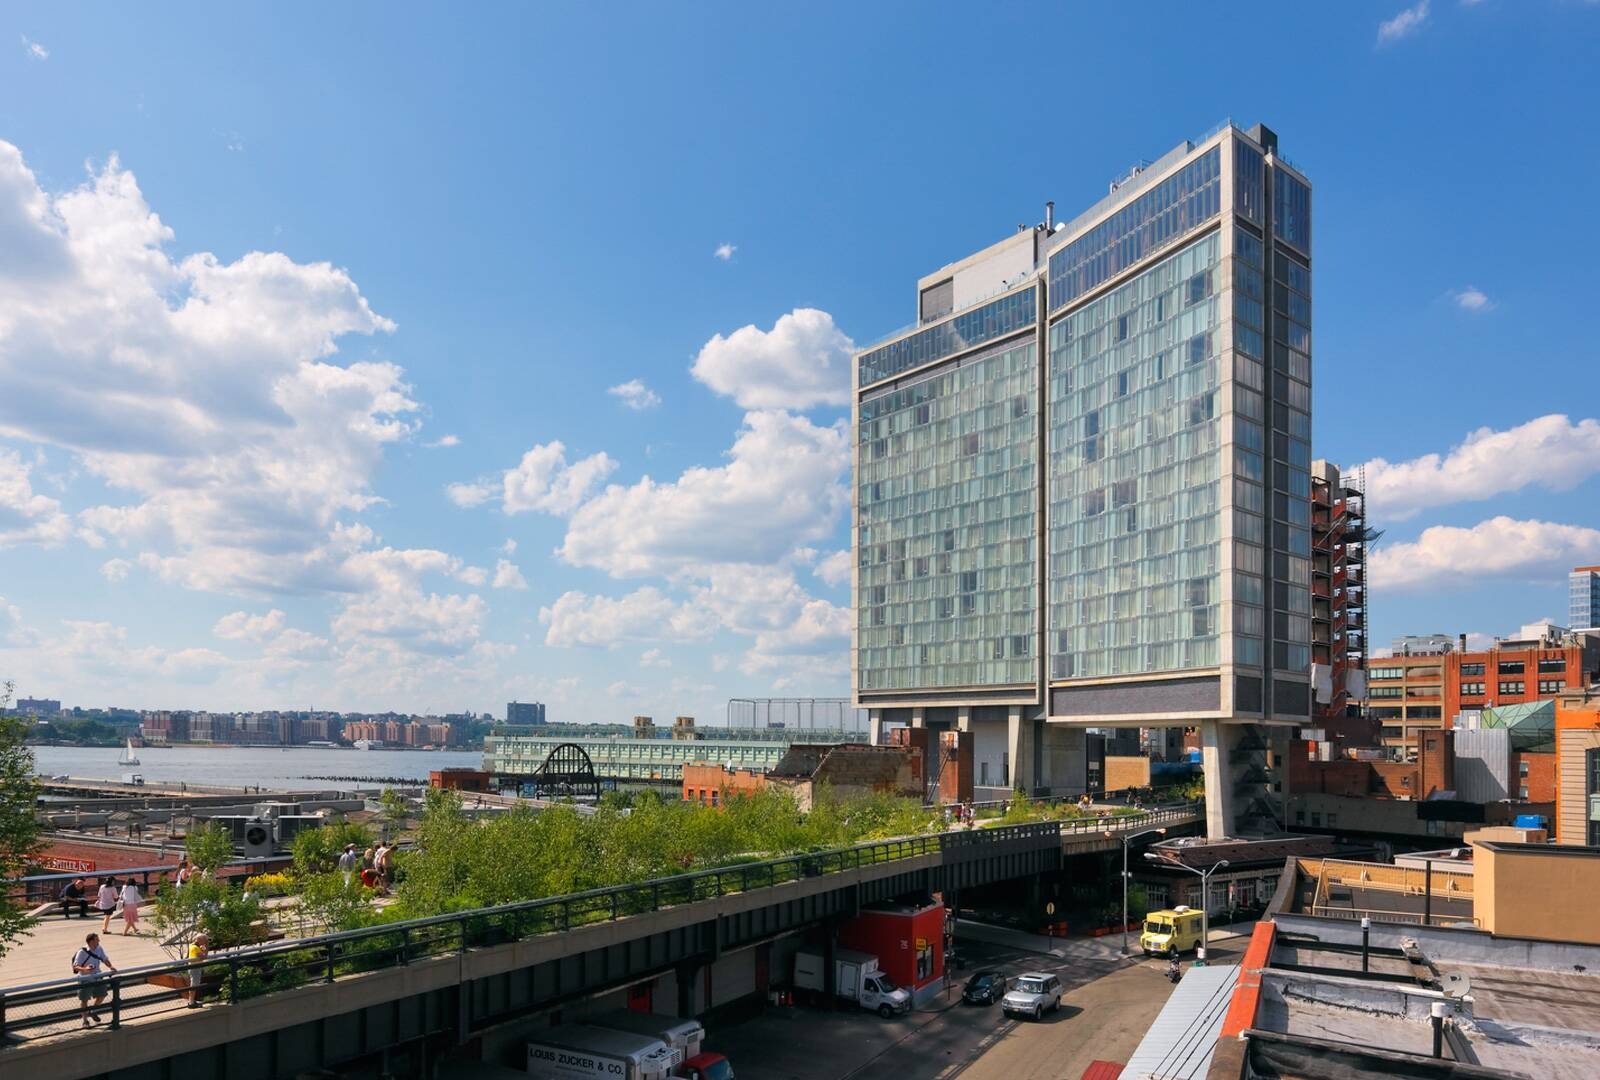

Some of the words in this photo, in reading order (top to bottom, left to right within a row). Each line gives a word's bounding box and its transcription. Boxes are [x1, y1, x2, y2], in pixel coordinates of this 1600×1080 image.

[529, 1047, 556, 1062] LOUIS
[558, 1053, 594, 1069] ZUCKER
[597, 1061, 604, 1072] &
[607, 1063, 624, 1075] CO.
